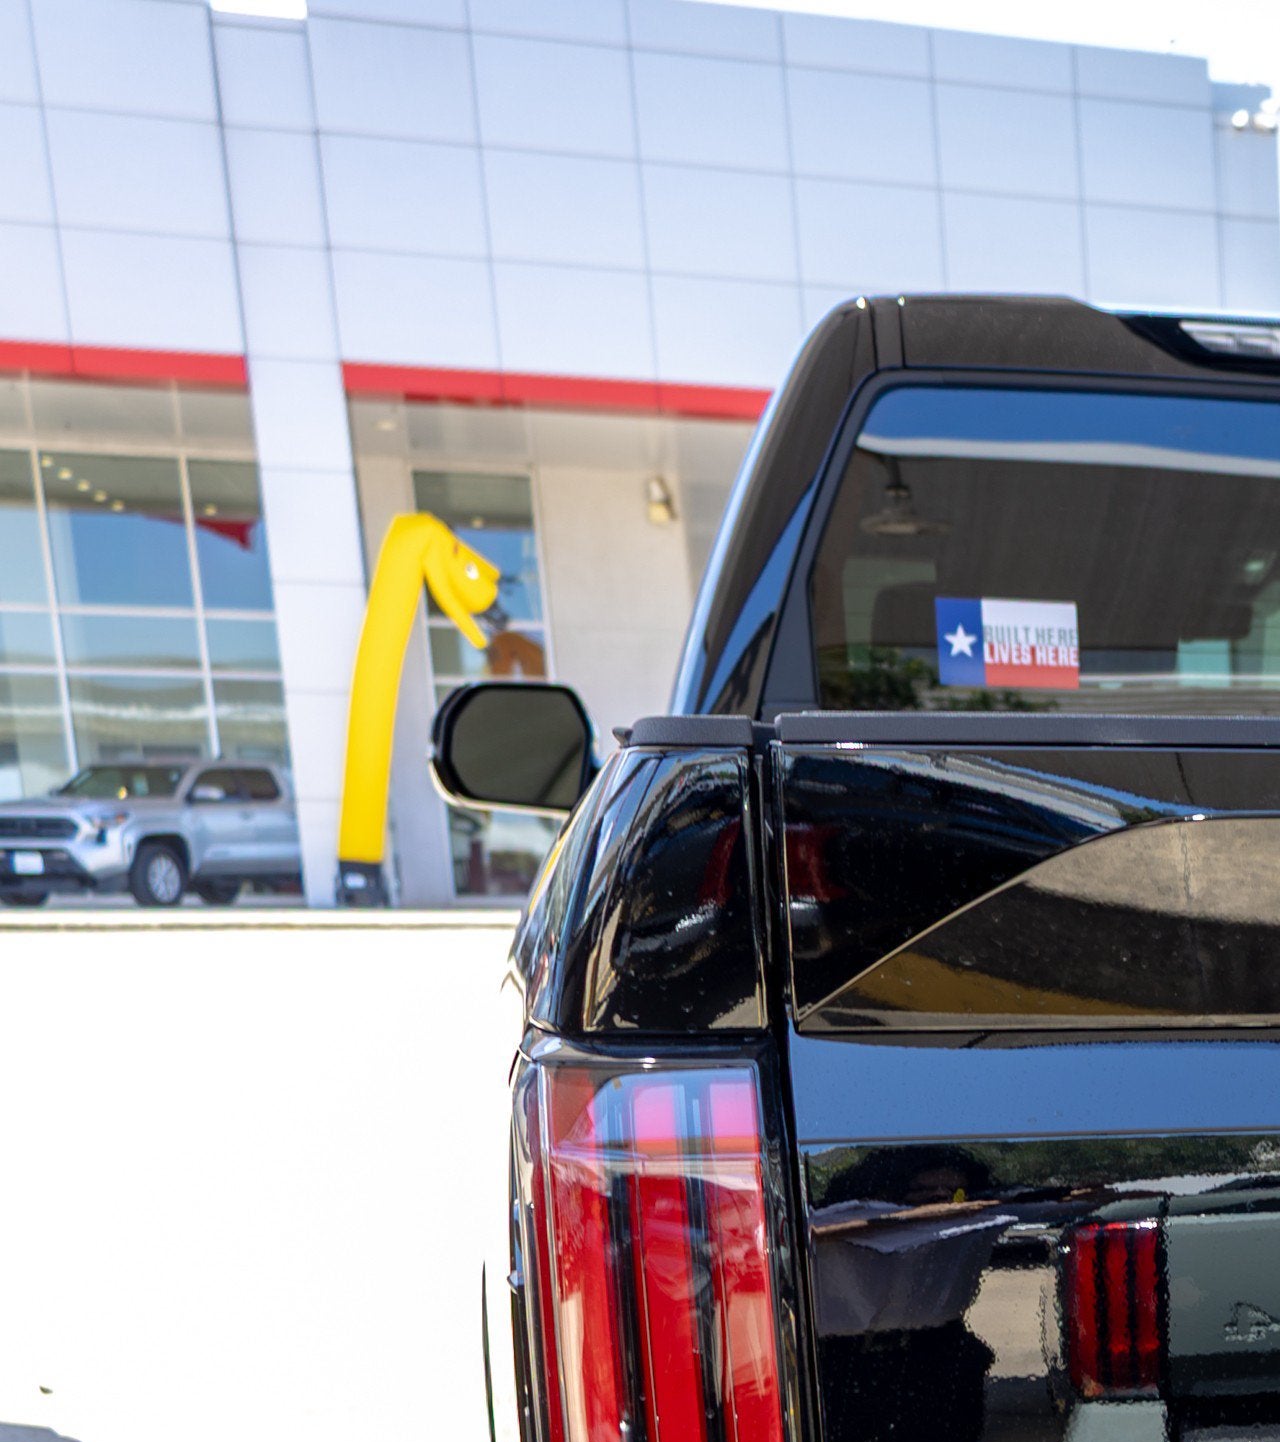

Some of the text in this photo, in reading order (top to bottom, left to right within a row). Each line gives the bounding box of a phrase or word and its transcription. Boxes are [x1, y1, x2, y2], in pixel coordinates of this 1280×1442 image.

[983, 625, 1078, 647] BUILT HERE
[984, 642, 1079, 667] LIVES HERE
